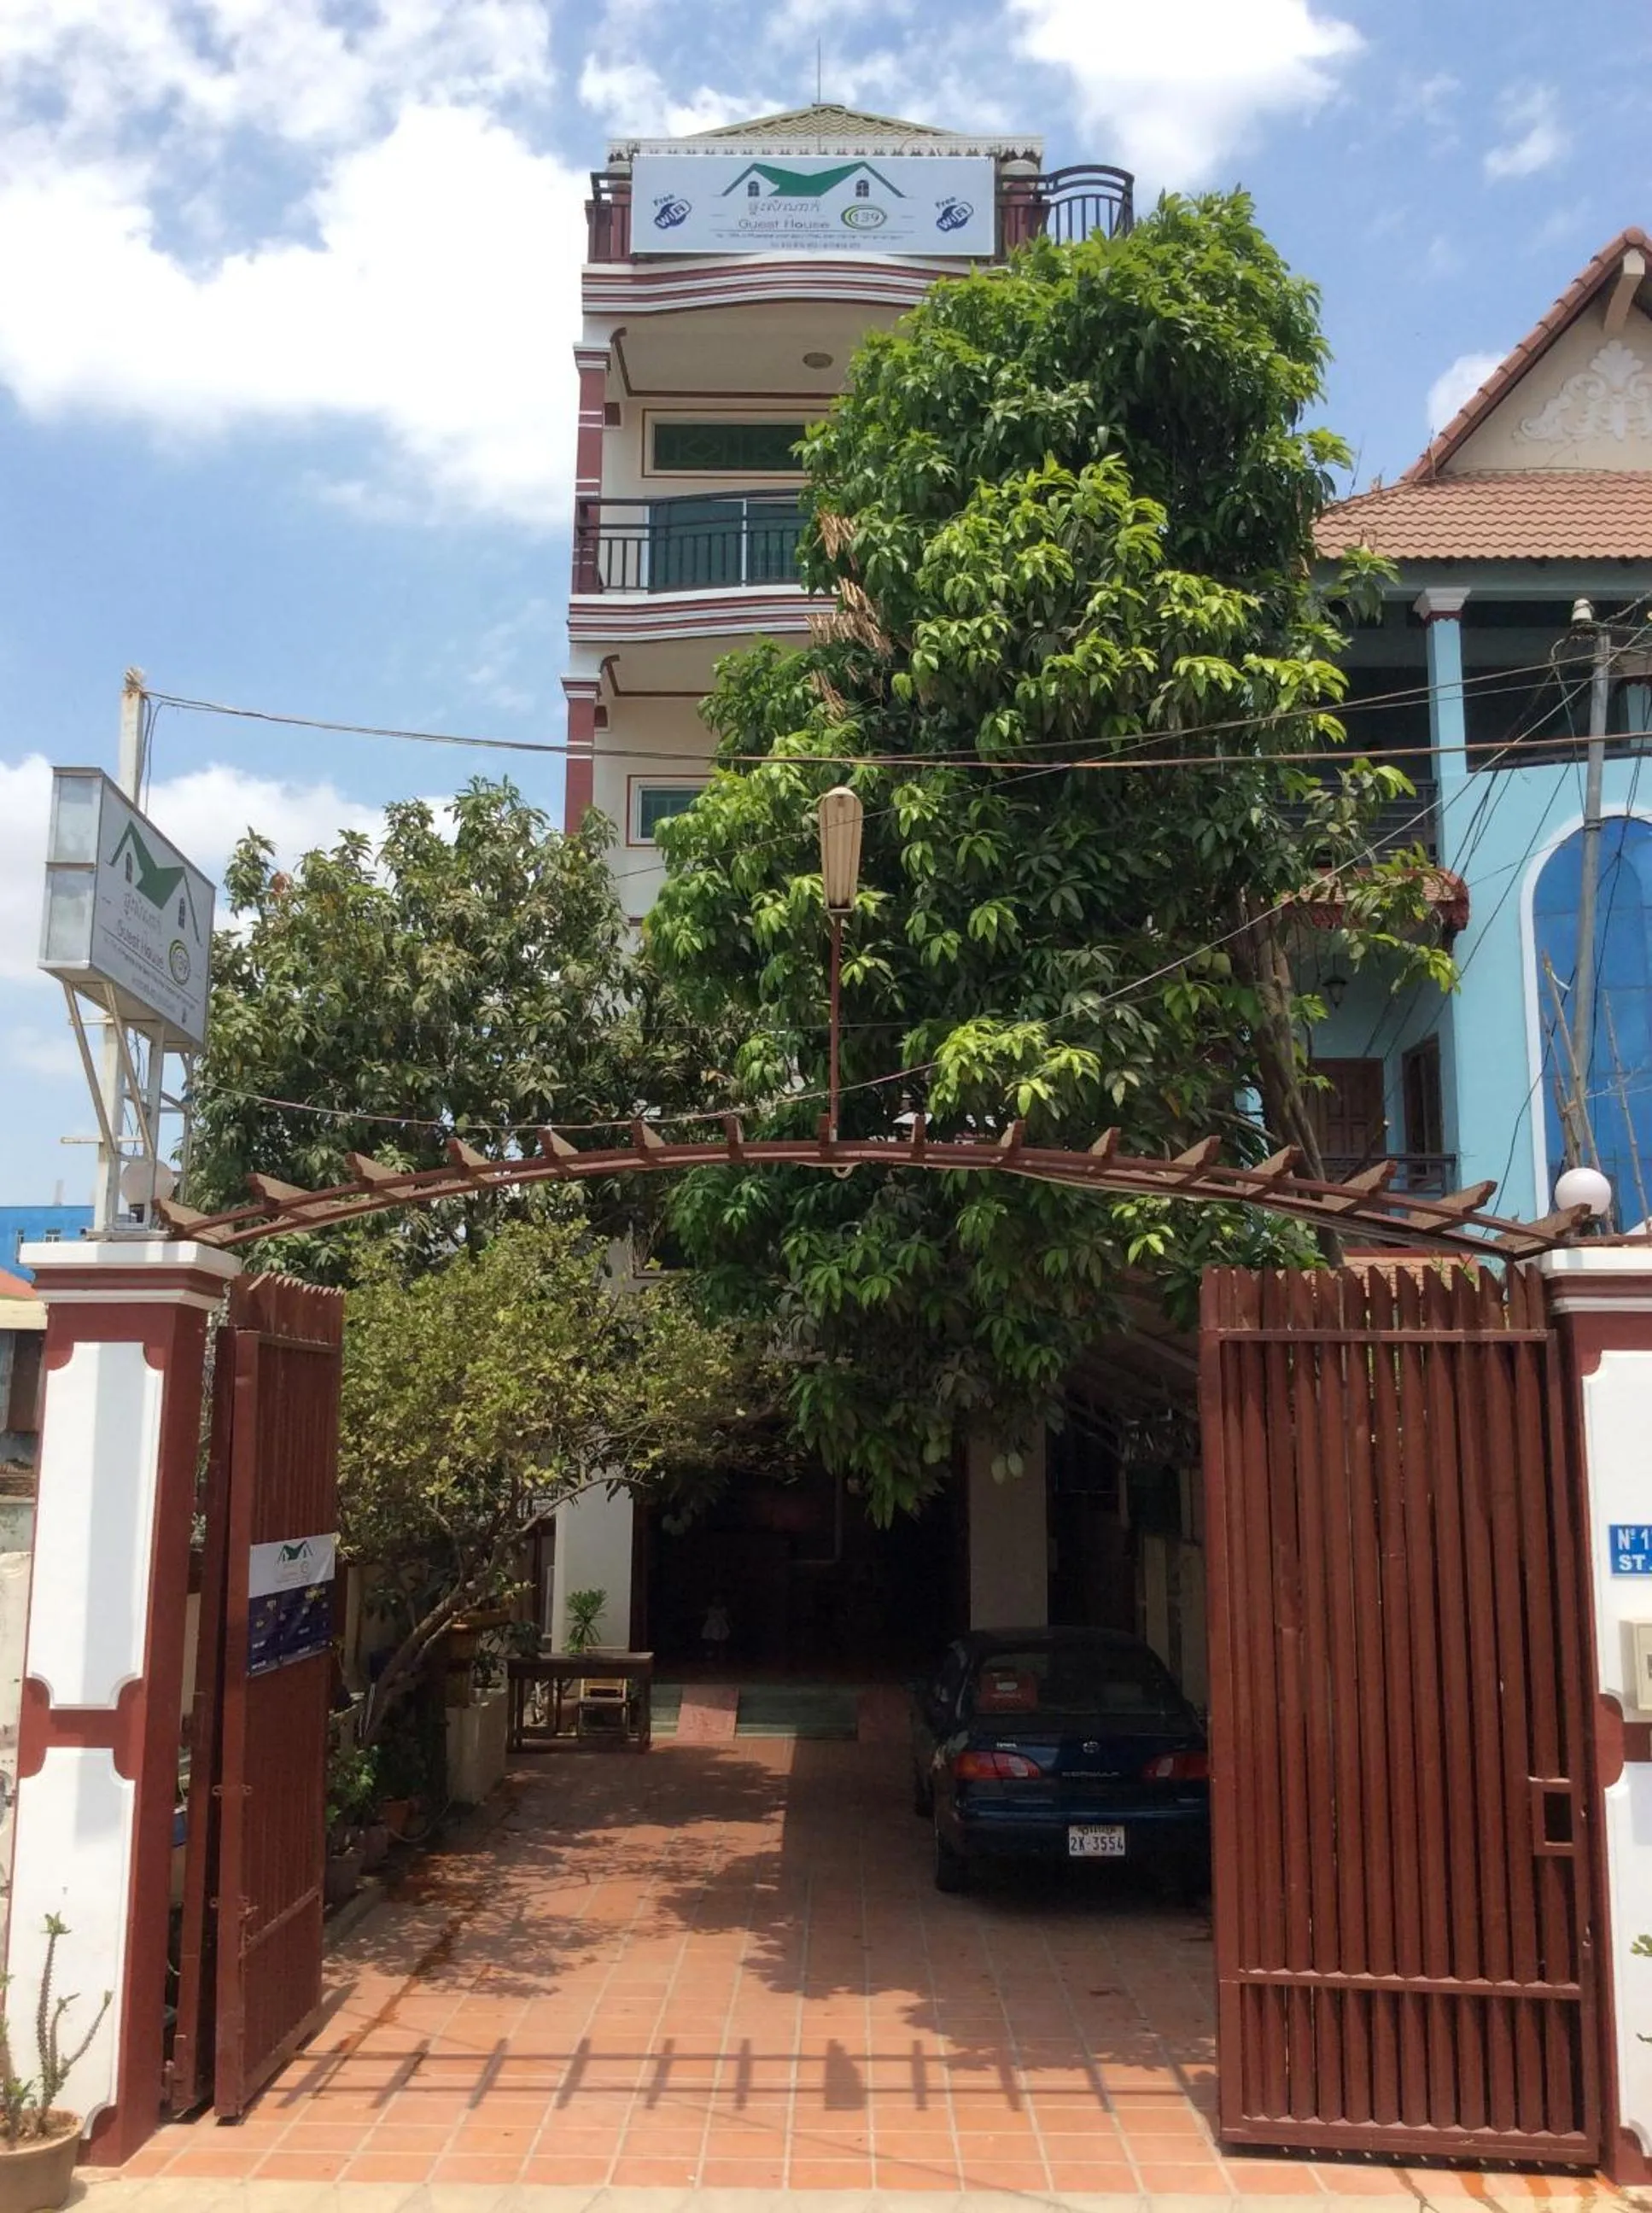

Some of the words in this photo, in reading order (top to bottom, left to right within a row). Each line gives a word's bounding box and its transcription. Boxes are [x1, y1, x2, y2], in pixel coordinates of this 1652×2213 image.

[738, 219, 779, 230] Guest
[784, 219, 831, 230] House
[1640, 1527, 1652, 1550] 1
[1071, 1836, 1124, 1851] 2K-3554
